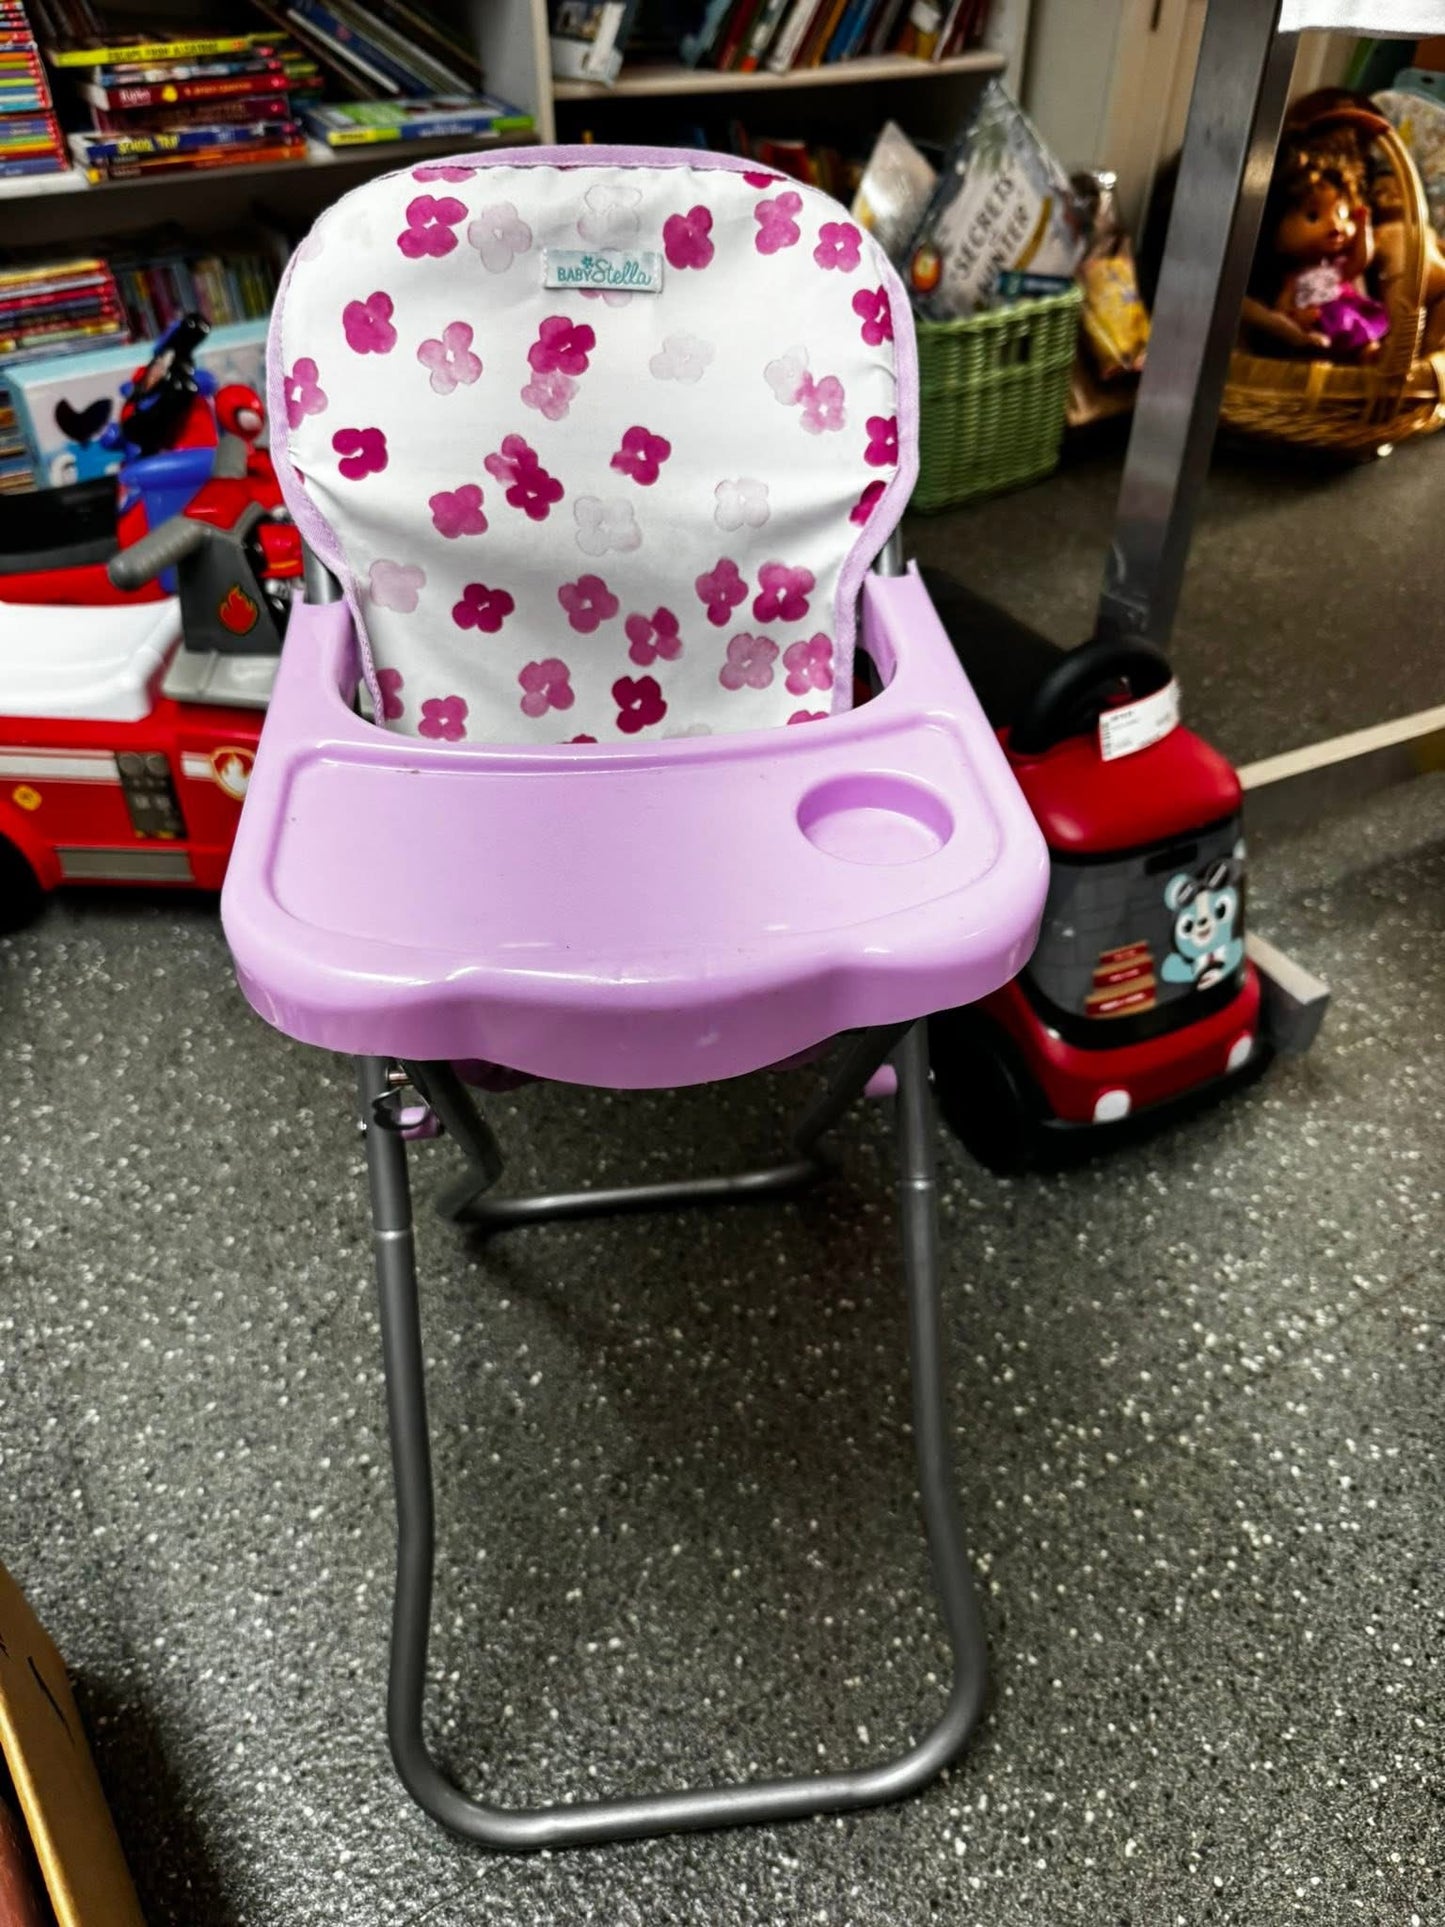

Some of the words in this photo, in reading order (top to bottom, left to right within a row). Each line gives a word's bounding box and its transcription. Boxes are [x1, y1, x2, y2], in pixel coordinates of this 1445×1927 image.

[953, 177, 1013, 275] SECRETS
[557, 268, 592, 281] BABY
[592, 257, 652, 285] Stella
